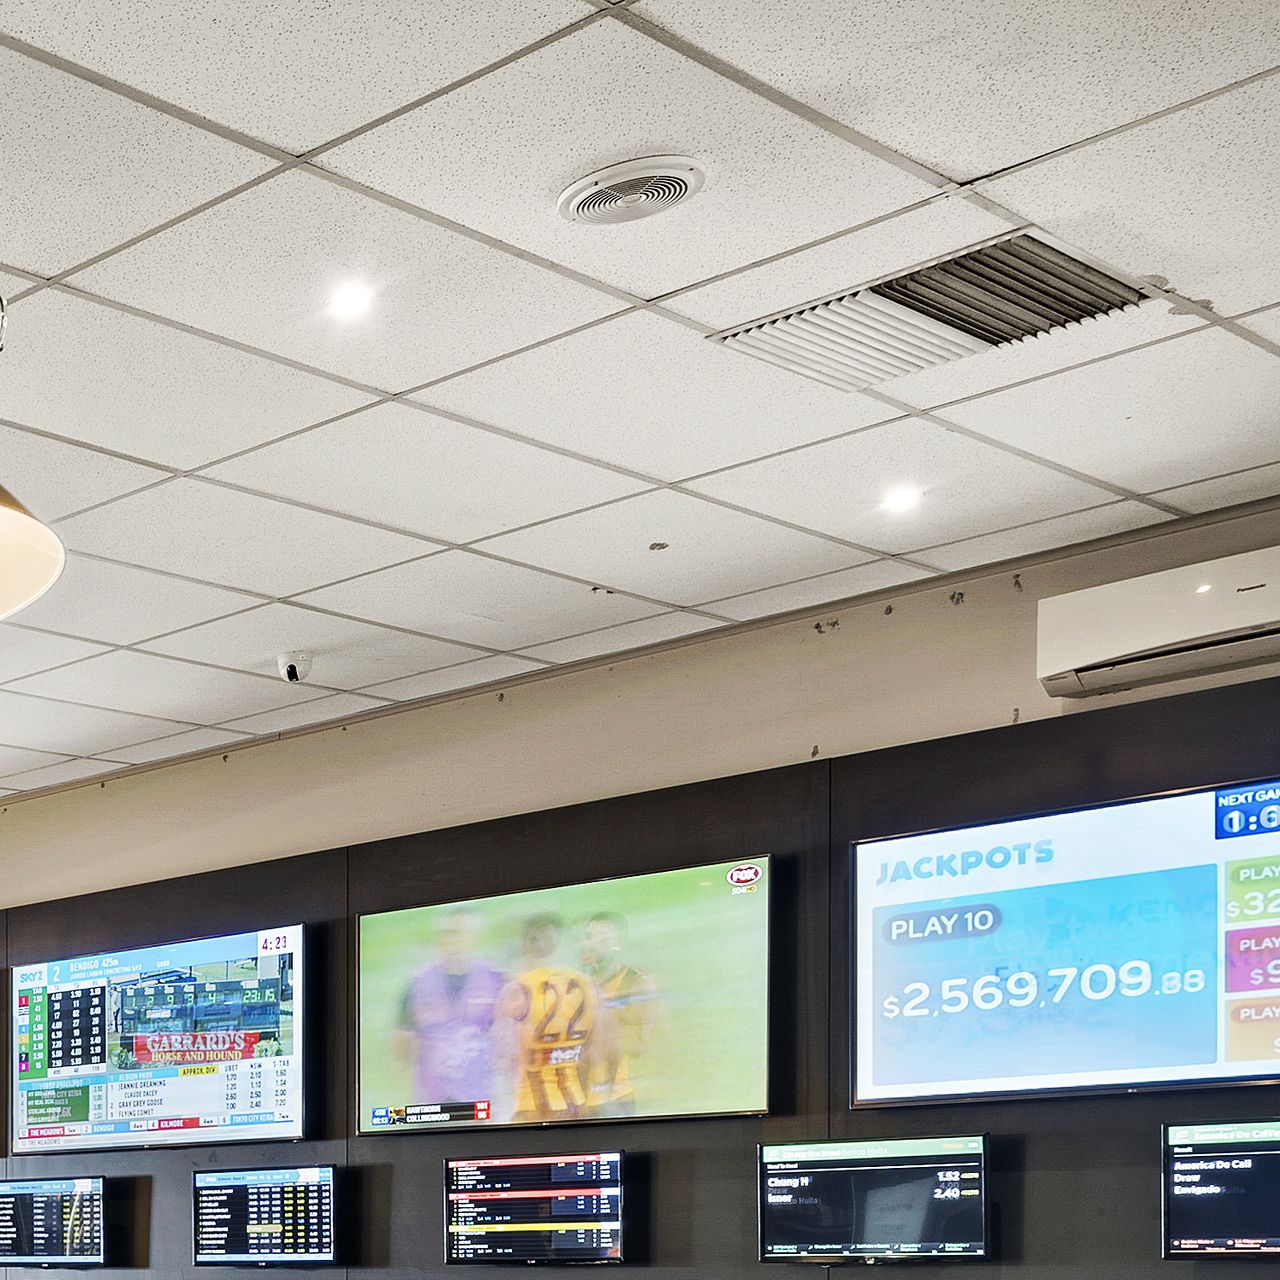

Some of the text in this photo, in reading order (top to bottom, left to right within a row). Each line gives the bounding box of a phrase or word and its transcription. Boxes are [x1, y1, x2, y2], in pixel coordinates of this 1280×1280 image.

[1219, 792, 1254, 807] NEXT
[876, 839, 1054, 886] JACKPOTS
[732, 868, 756, 882] FOX
[890, 909, 994, 941] PLAY 10
[20, 971, 44, 984] SKY2
[52, 966, 60, 982] 2
[536, 979, 590, 1042] 22
[146, 1032, 246, 1052] GARRARD'S
[151, 1050, 243, 1062] HORSE AND HOUND
[406, 1113, 451, 1123] COLLINGWOOD
[1173, 1159, 1252, 1171] America De Cali
[767, 1177, 800, 1188] Chung
[936, 1170, 960, 1181] 1.52
[1173, 1173, 1201, 1183] Draw
[933, 1187, 960, 1199] 2.40
[1173, 1184, 1221, 1195] Envigado
